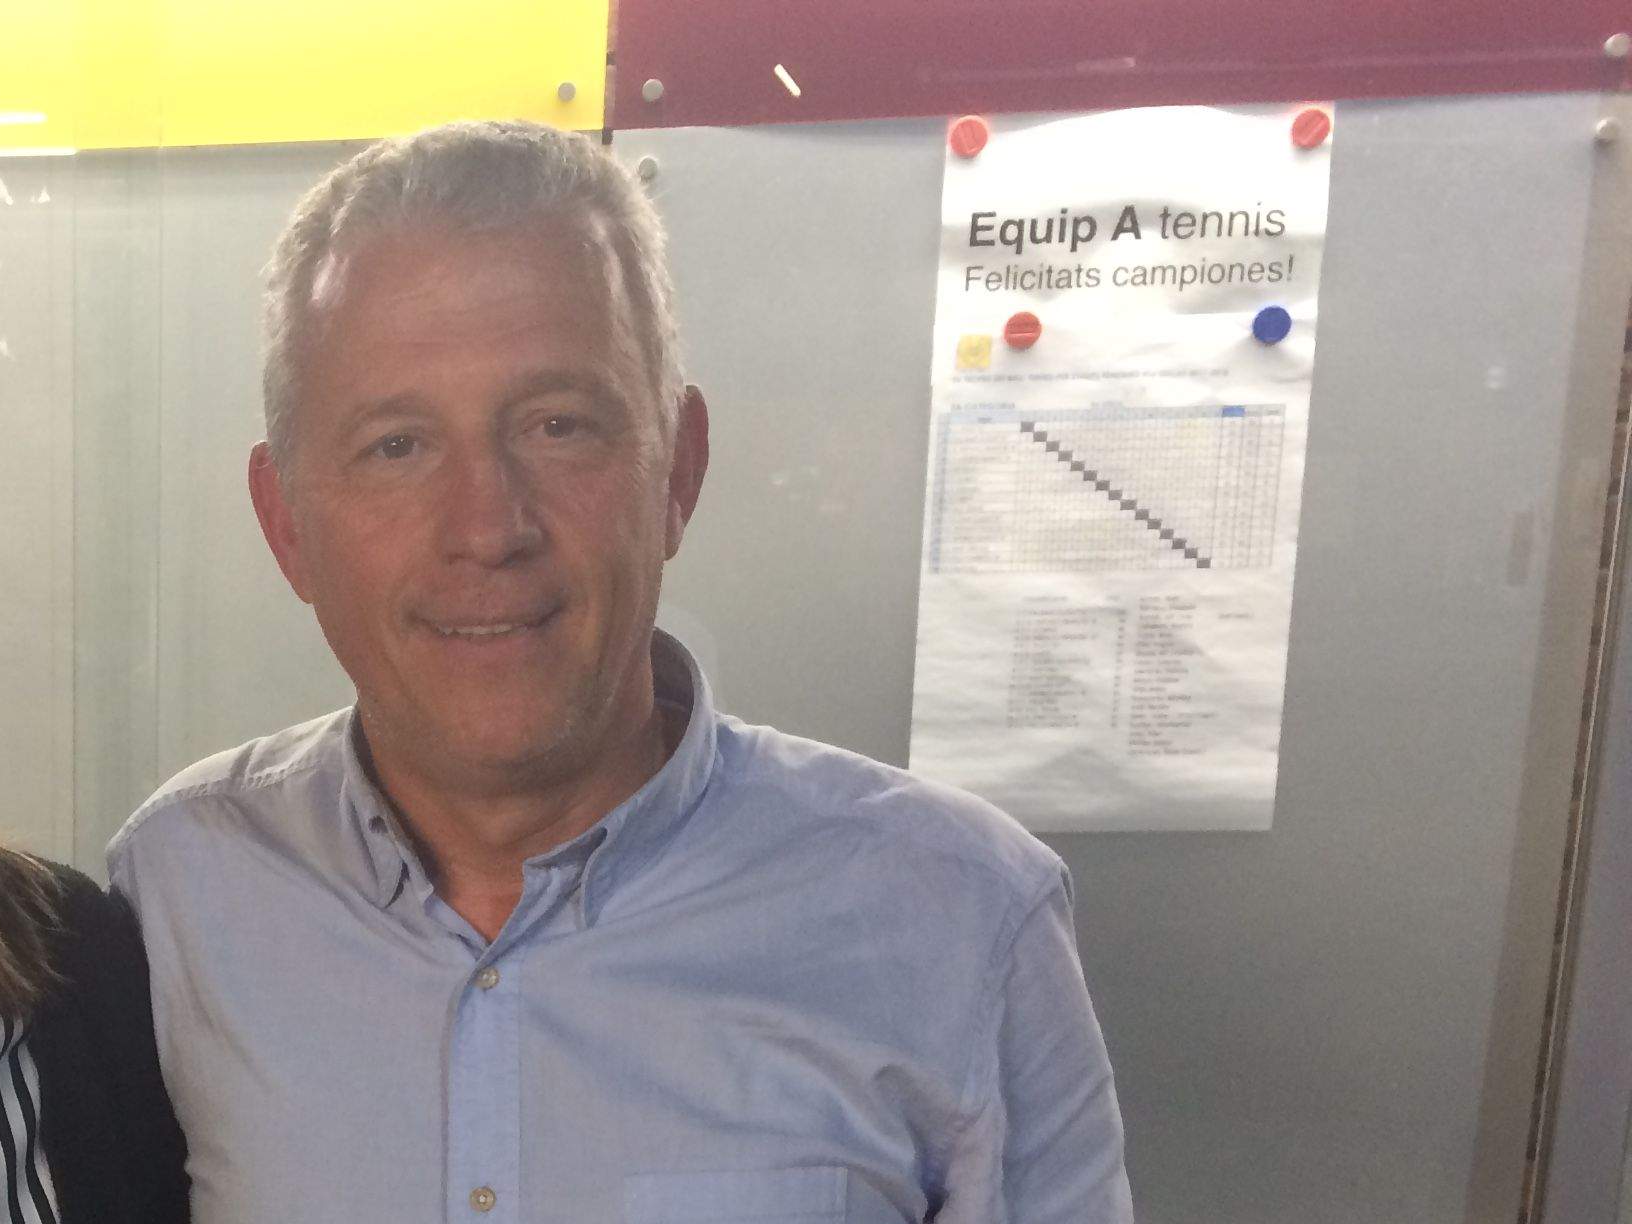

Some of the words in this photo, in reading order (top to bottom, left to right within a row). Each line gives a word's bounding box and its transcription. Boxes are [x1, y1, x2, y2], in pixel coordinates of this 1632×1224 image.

[969, 208, 1097, 254] Equip
[1111, 205, 1142, 240] A
[1159, 202, 1287, 240] tennis
[964, 263, 1101, 292] Felicitats
[1112, 254, 1294, 291] campiones!
